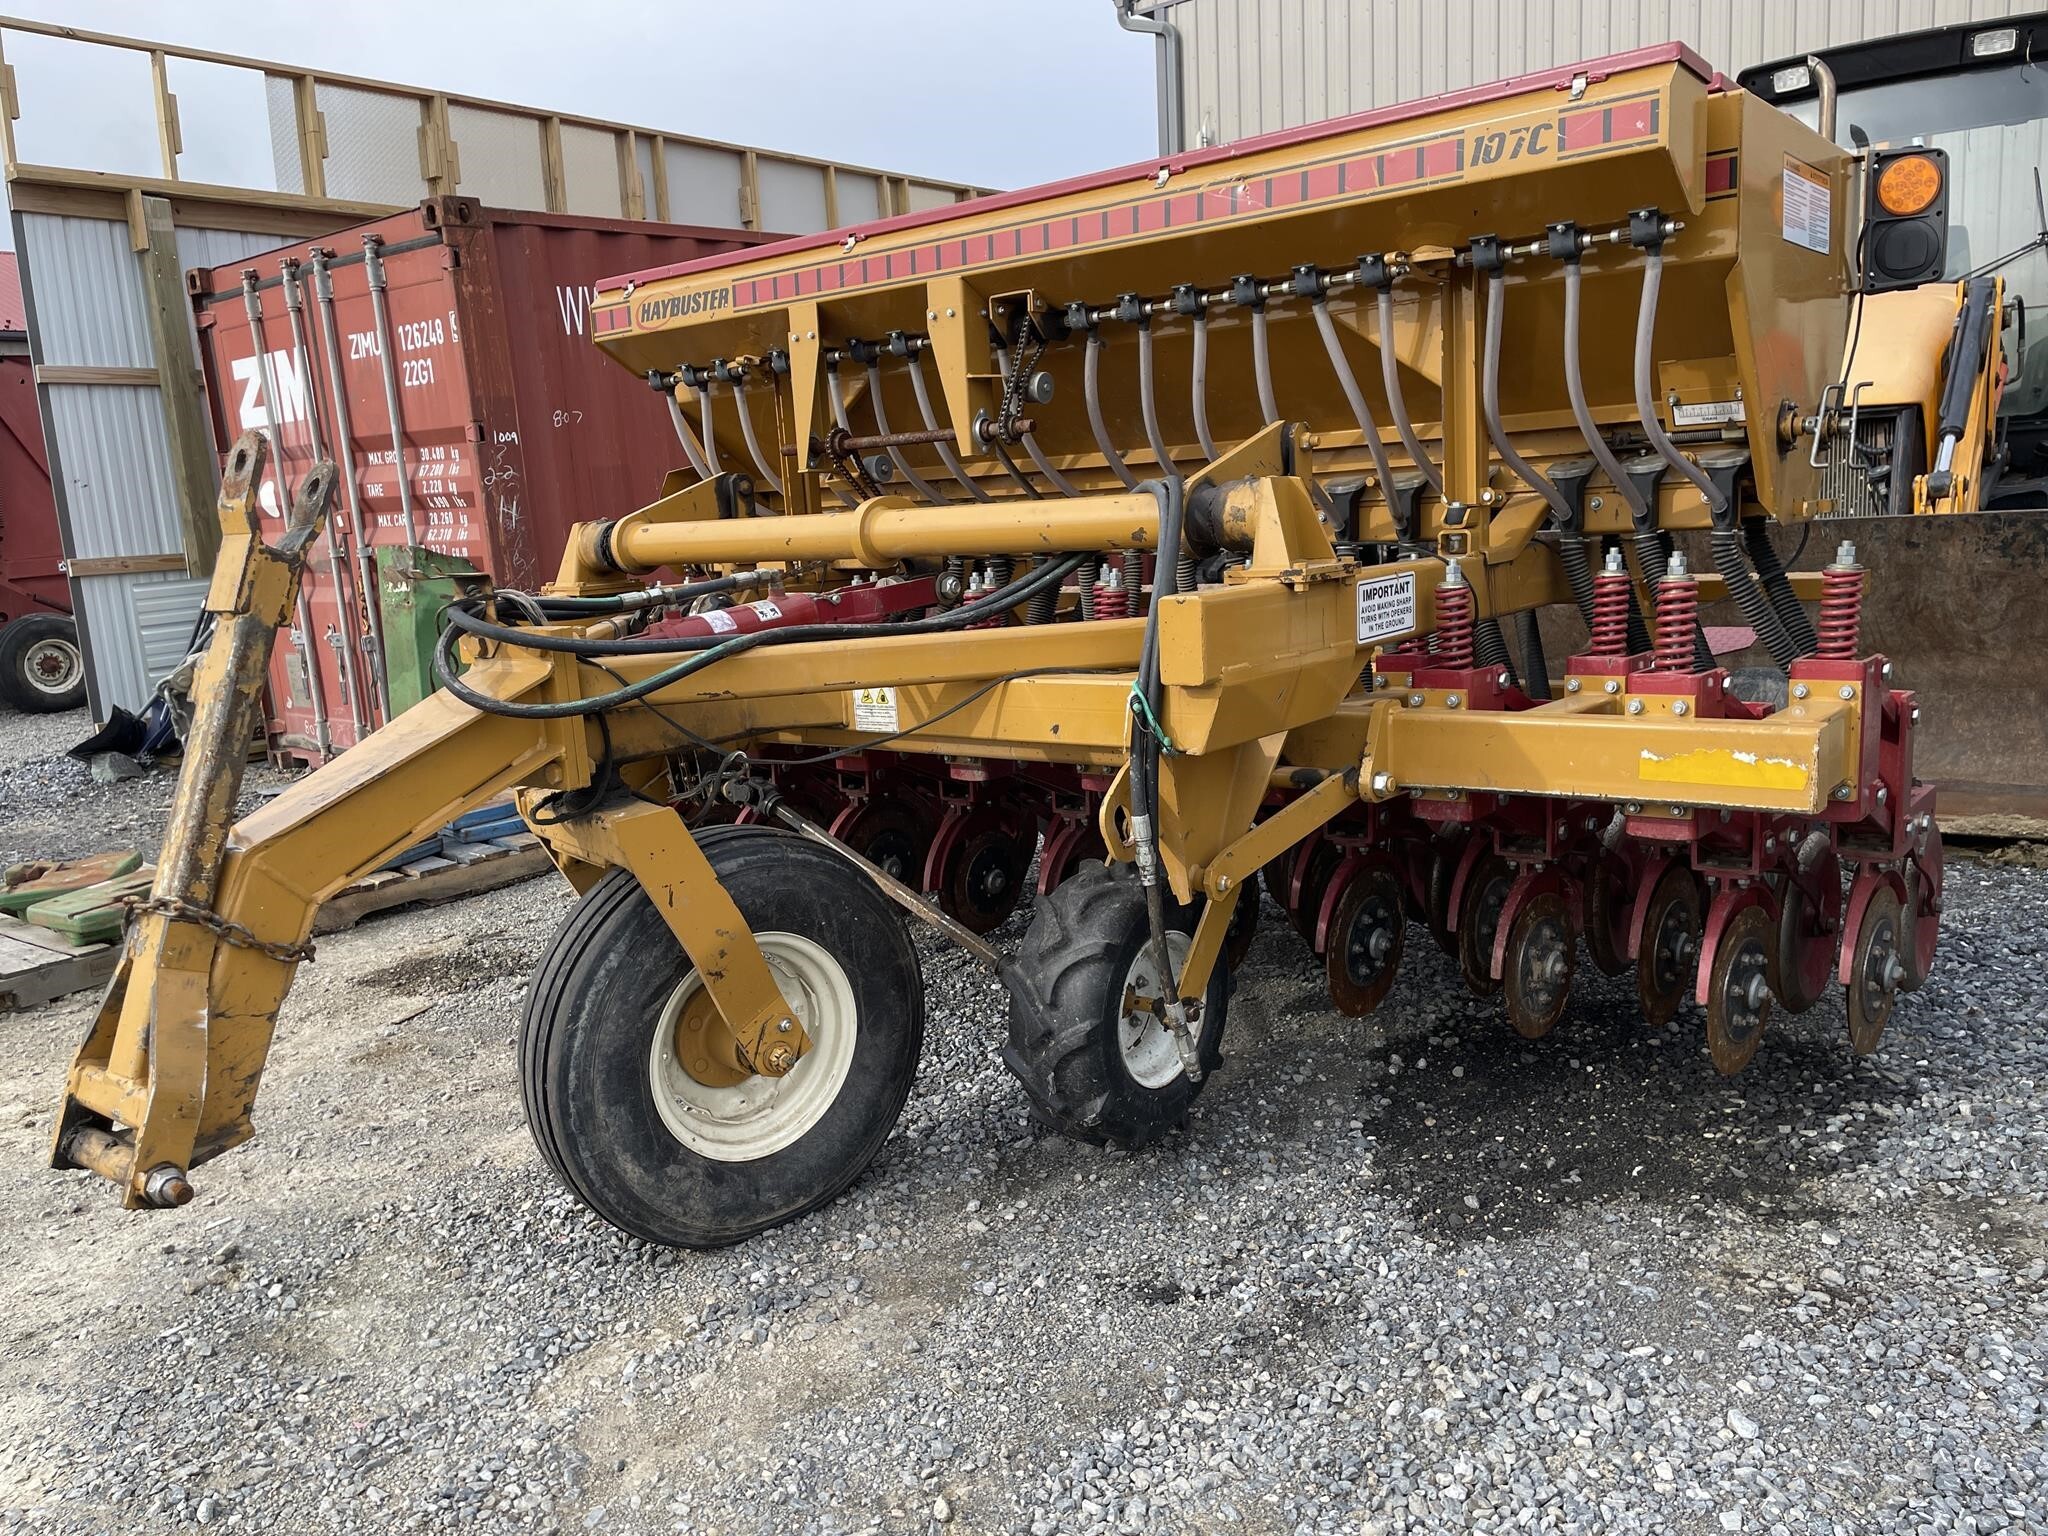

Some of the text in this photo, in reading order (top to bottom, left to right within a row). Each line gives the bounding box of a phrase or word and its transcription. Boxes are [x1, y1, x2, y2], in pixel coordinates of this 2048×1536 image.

[1470, 123, 1553, 167] 107C
[640, 287, 729, 323] HAYBUSTER
[348, 330, 381, 360] ZIMU
[398, 318, 444, 352] 126248
[403, 358, 434, 387] 22G1
[232, 345, 317, 429] ZIM
[494, 430, 518, 445] 1009
[420, 447, 445, 461] 30.480
[450, 446, 459, 462] kg
[448, 463, 460, 474] lbs
[367, 479, 457, 497] TARE 2.220 kg
[452, 496, 467, 507] lbs
[429, 512, 453, 525] 28.260
[459, 511, 468, 527] kg
[427, 528, 468, 541] 62.310 lbs
[1362, 581, 1410, 602] IMPORTANT
[1361, 596, 1411, 614] AVOID MAKING SHARP
[1361, 606, 1412, 624] TURNS WITH OPENERS
[1375, 621, 1384, 631] THE
[1385, 617, 1405, 628] GROUND
